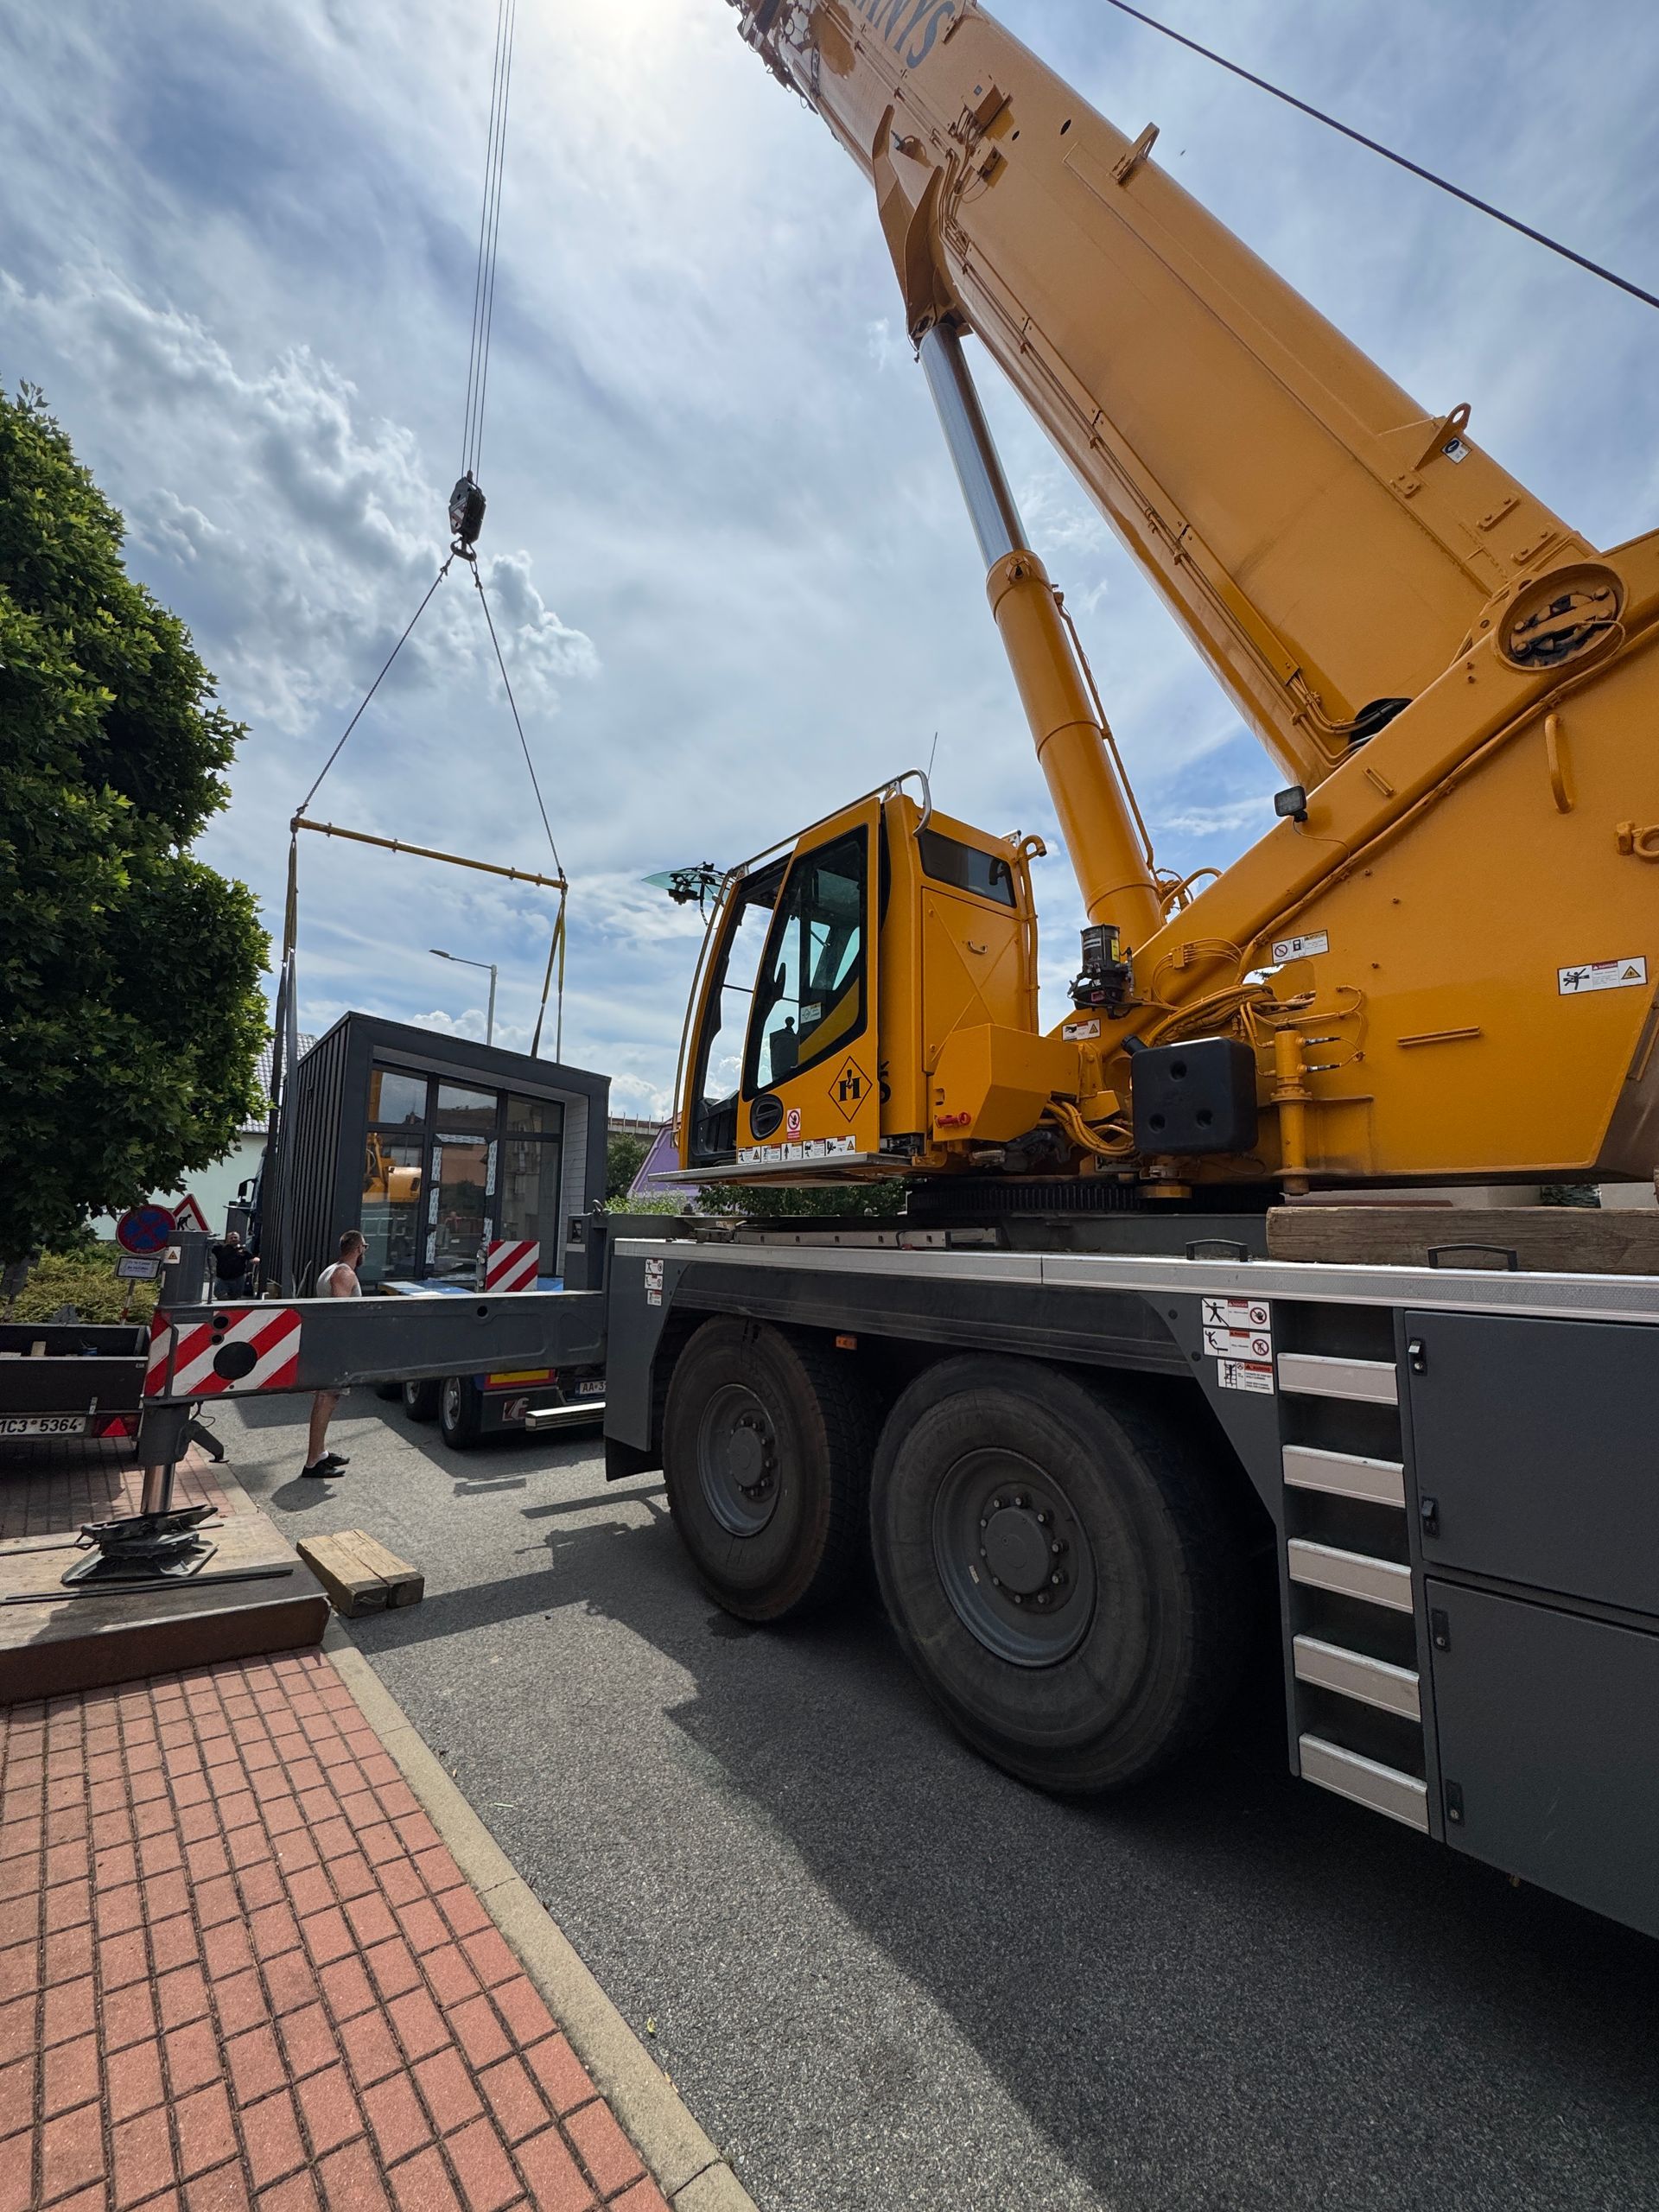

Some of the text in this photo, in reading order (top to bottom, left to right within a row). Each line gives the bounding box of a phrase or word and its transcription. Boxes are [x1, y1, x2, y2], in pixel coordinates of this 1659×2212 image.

[582, 1382, 594, 1392] AA
[0, 1418, 78, 1433] 1C3 5364
